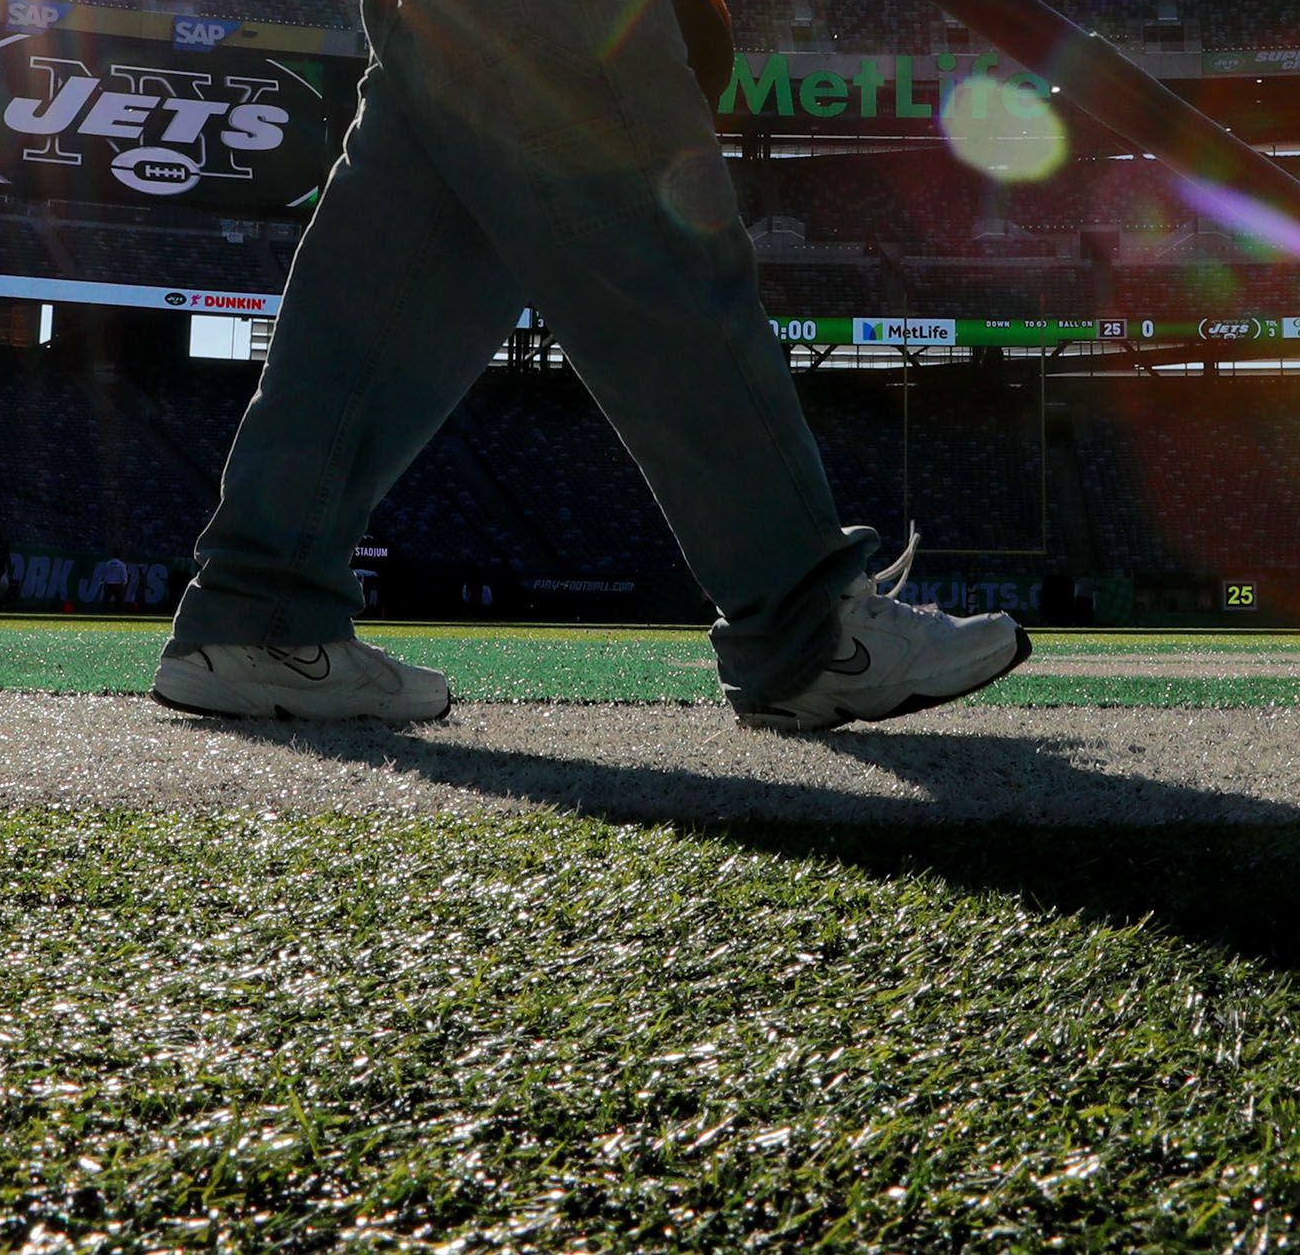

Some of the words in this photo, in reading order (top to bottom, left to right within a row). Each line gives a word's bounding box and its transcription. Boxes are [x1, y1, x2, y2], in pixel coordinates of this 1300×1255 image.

[8, 2, 60, 29] SAP
[175, 21, 226, 46] SAP
[715, 52, 1051, 118] MetLife
[3, 76, 290, 151] JETS
[204, 296, 266, 310] DUNKIN'
[986, 320, 1010, 328] DOWN
[1024, 320, 1035, 328] TO
[1058, 320, 1079, 328] BALL
[1081, 320, 1093, 328] ON
[1103, 323, 1121, 336] 25
[1141, 320, 1154, 338] 0
[1208, 322, 1249, 335] JETS
[888, 325, 948, 339] MetLife
[1267, 327, 1277, 337] 3
[354, 547, 388, 558] STADIUM
[1227, 585, 1254, 605] 25
